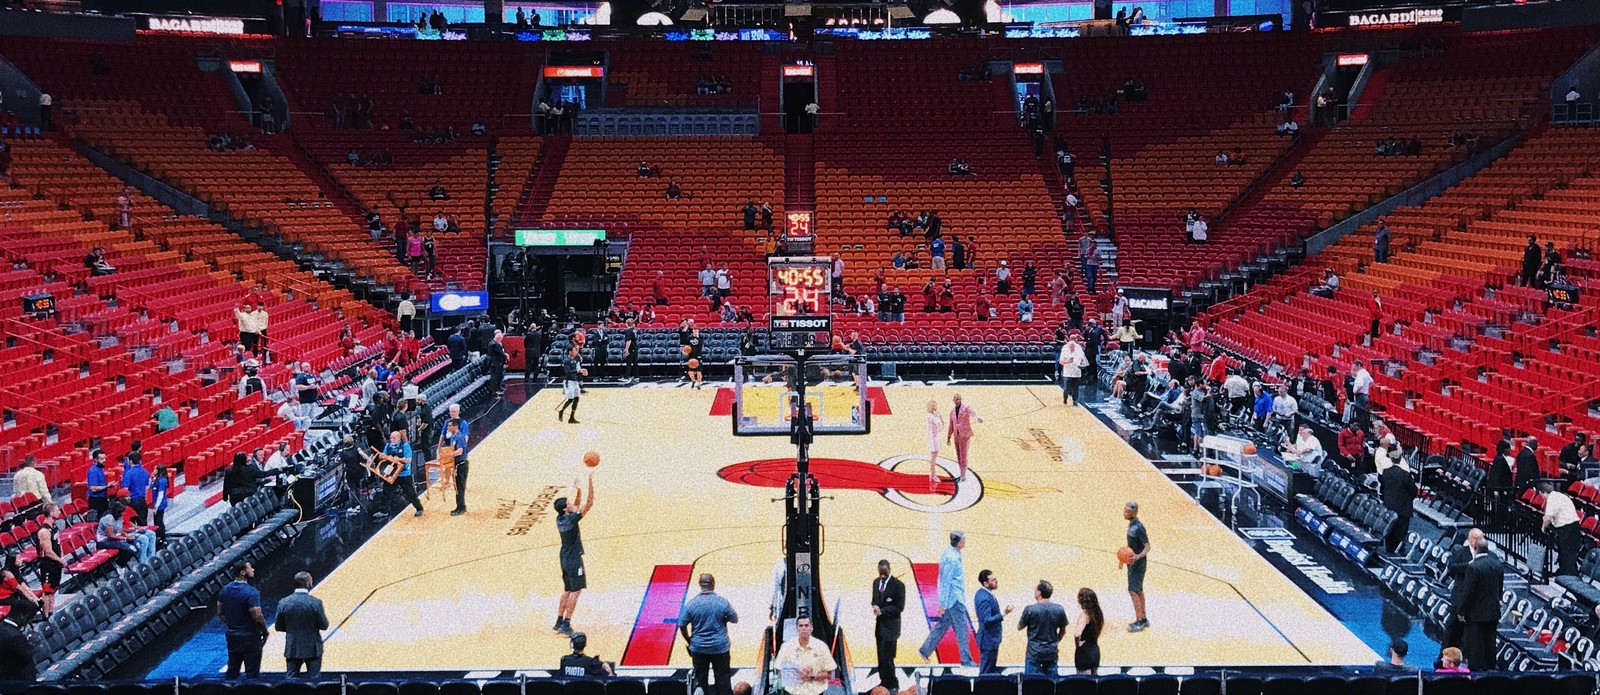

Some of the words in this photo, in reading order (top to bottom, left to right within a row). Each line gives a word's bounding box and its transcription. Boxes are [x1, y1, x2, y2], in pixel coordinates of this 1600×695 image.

[790, 221, 808, 236] 24
[778, 269, 823, 286] 40:55
[783, 286, 819, 313] 24
[789, 319, 828, 328] TISSOT
[565, 666, 585, 677] PHOTO
